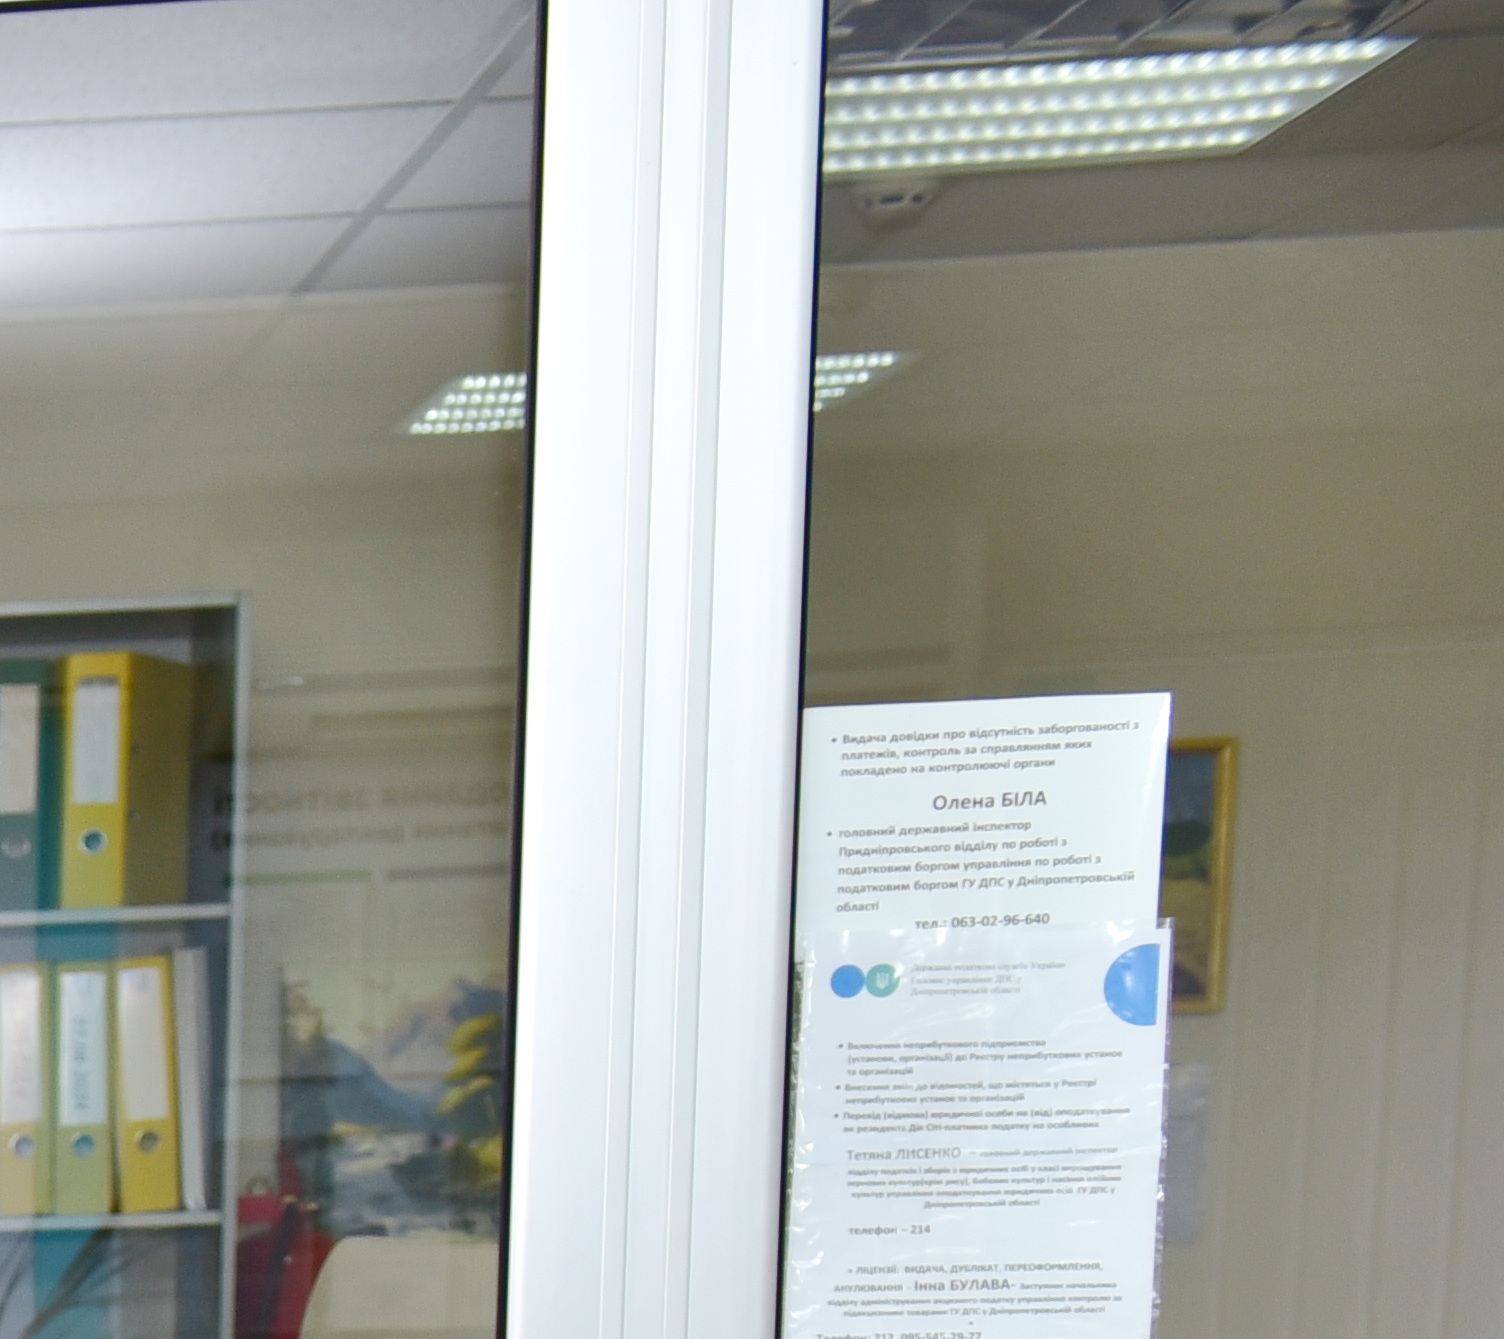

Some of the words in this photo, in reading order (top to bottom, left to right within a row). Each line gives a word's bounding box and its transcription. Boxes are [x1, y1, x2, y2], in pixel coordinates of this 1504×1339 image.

[842, 734, 887, 745] Видача
[889, 731, 940, 744] довідки
[942, 730, 966, 741] про
[969, 727, 1035, 739] відсутність
[1038, 722, 1130, 735] заборгованості
[932, 794, 995, 811] Олена
[1001, 790, 1047, 808] БІЛА
[914, 920, 948, 931] тел.:
[951, 913, 1051, 928] 063-02-96-640
[847, 1149, 892, 1161] Тетяна
[895, 1147, 962, 1160] ЛИСЕНКО
